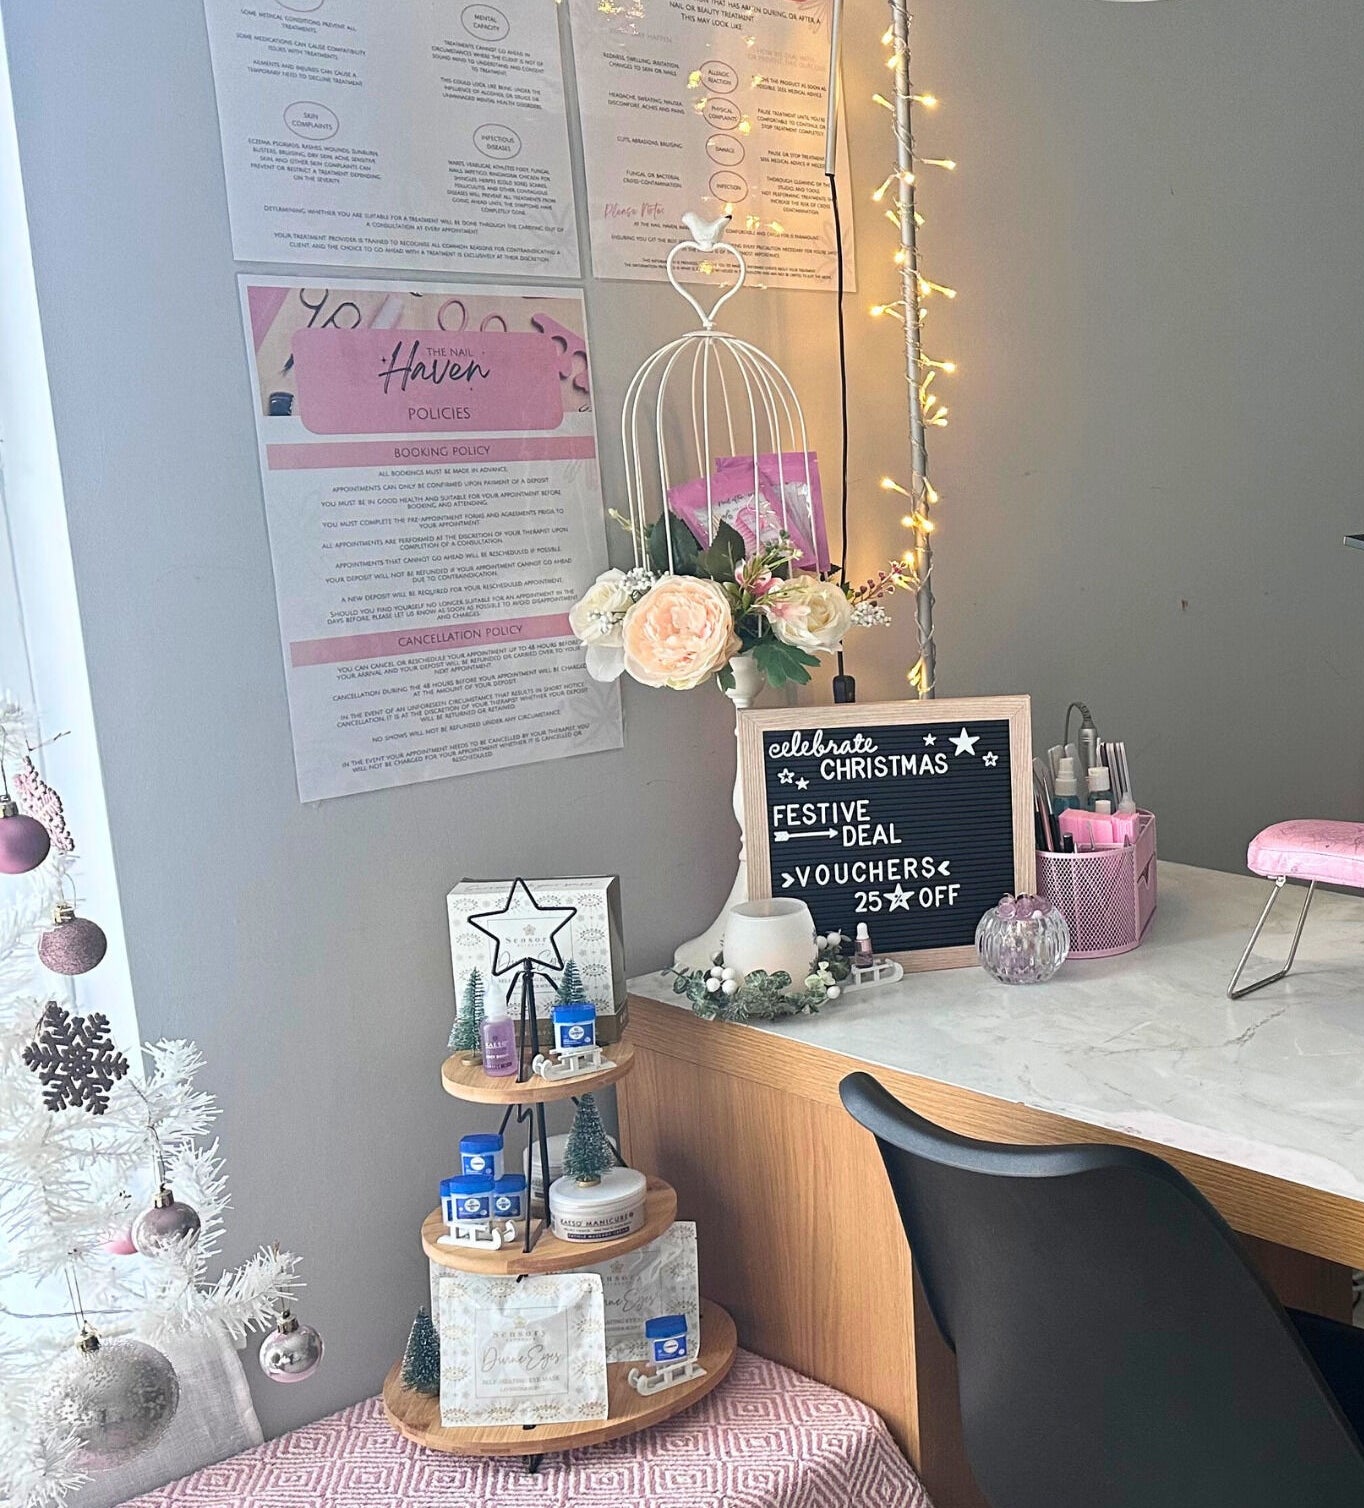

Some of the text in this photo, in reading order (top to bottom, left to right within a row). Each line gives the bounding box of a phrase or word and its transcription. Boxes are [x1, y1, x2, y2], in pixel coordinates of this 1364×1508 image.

[426, 348, 474, 358] THE NAIL
[378, 340, 490, 394] Haven
[408, 406, 471, 420] POLICIES
[394, 445, 490, 458] BOOKING POLICY
[398, 625, 523, 647] CANCELLATION POLICY
[768, 729, 879, 759] celebrate
[820, 753, 948, 780] CHRISTMAS
[773, 800, 872, 827] FESTIVE
[842, 824, 902, 848] DEAL
[795, 856, 937, 888] VOUCHERS
[854, 891, 882, 912] 25
[918, 884, 961, 908] OFF
